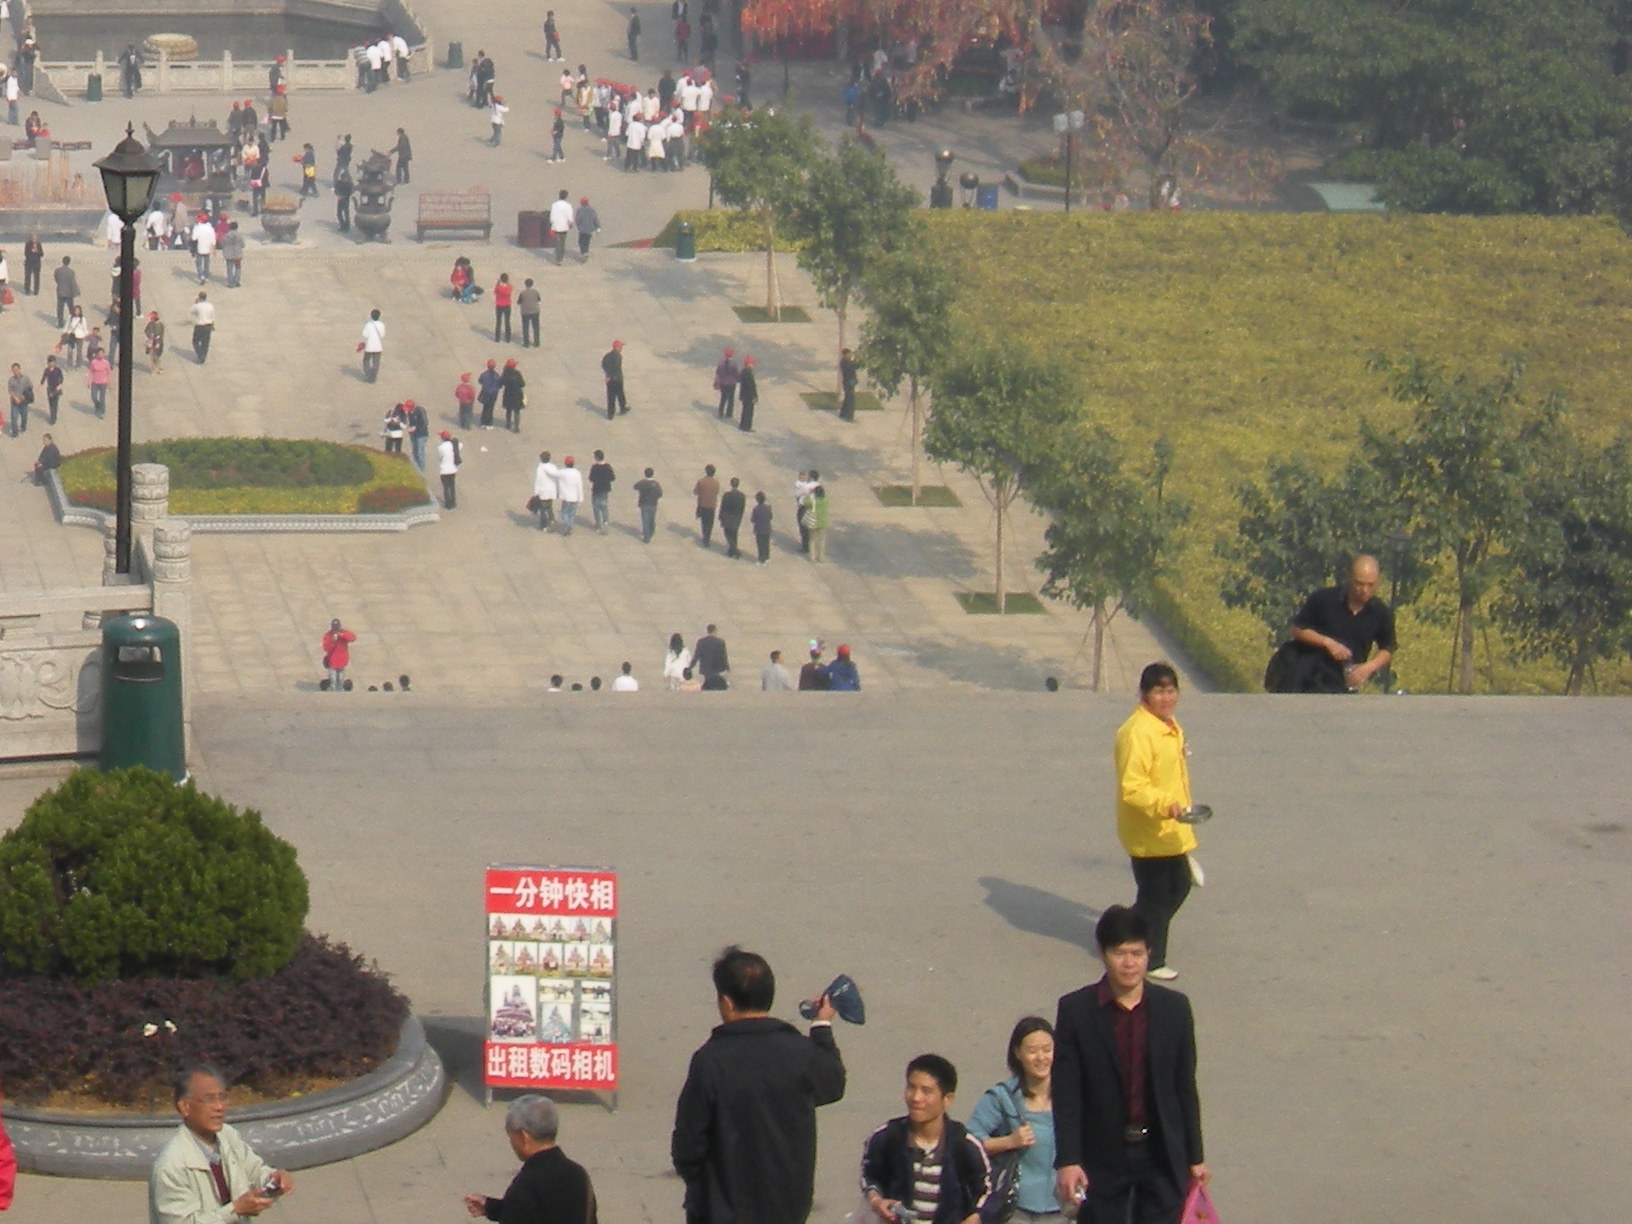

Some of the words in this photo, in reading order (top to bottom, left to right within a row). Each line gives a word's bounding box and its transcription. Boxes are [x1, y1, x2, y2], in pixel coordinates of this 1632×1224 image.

[489, 876, 614, 910] 一分钟快相
[487, 1046, 616, 1081] 出租数码相机
